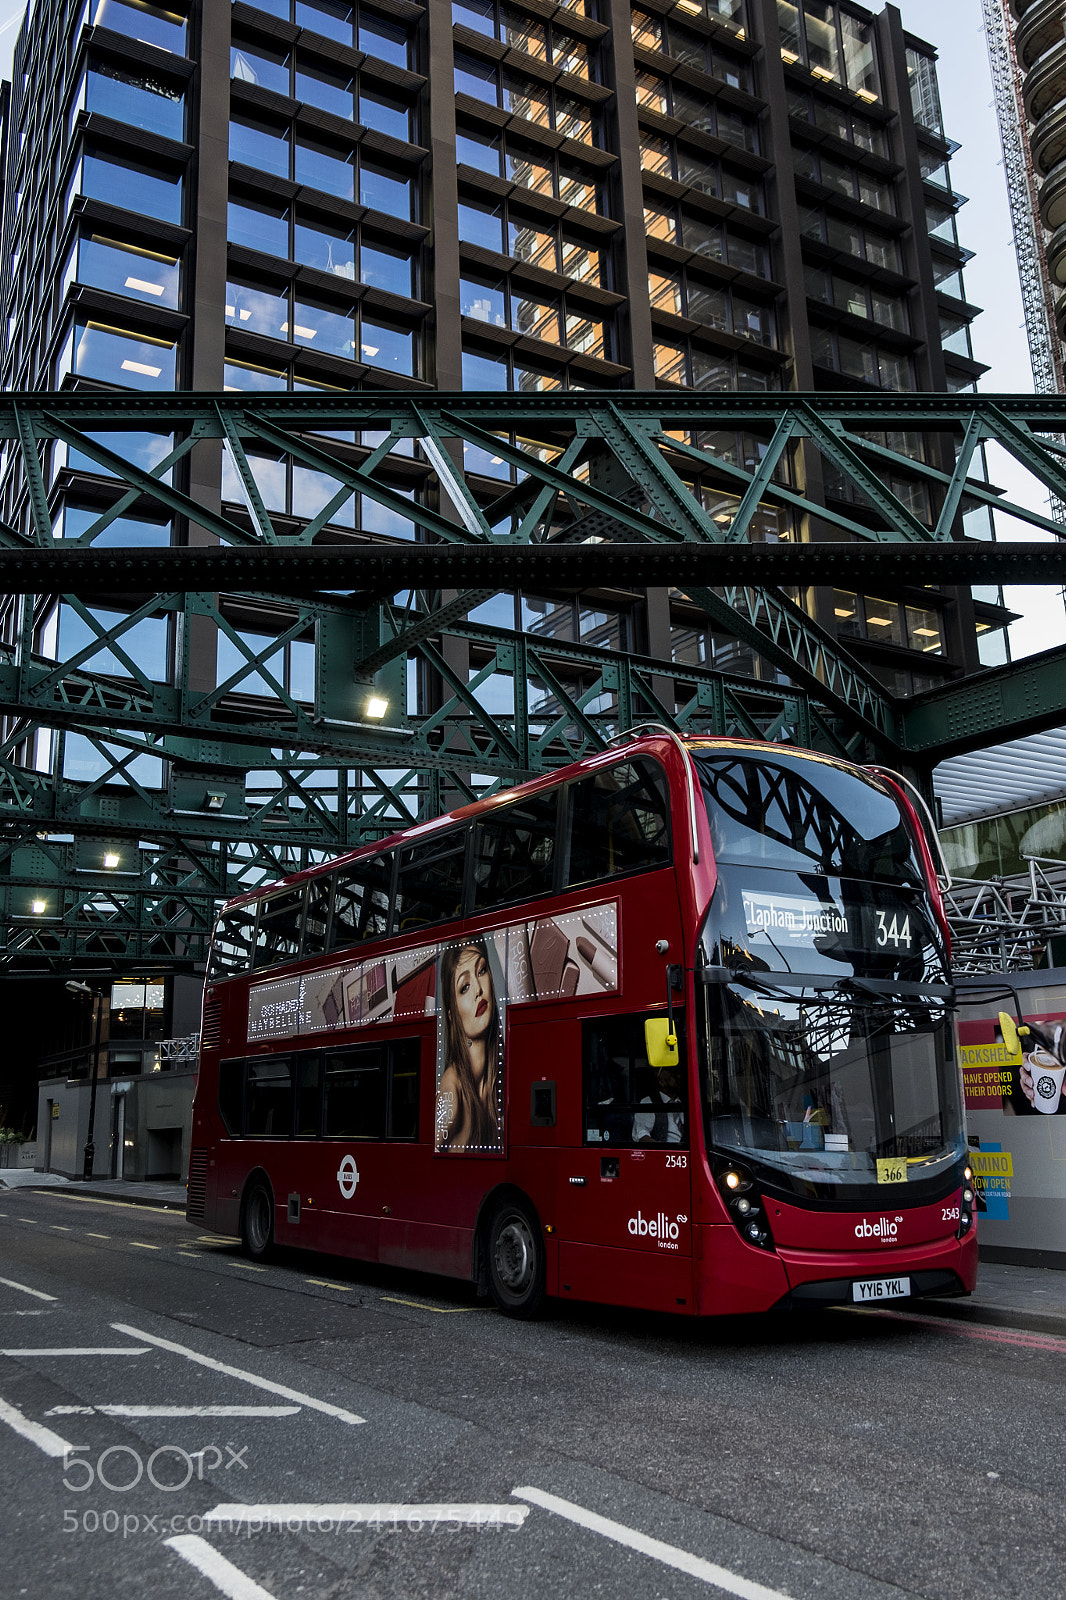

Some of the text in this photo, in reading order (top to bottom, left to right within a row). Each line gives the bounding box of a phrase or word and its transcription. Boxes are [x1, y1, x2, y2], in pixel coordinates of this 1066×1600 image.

[743, 900, 849, 933] Clapham Junction
[875, 910, 912, 949] 344
[961, 1047, 1015, 1064] ACKSHEE
[964, 1071, 1013, 1084] HAVE OPENED
[965, 1084, 1013, 1097] THEIR DOORS
[665, 1155, 687, 1168] 2543
[882, 1168, 903, 1182] 366
[990, 1178, 1010, 1189] OPEN
[942, 1208, 960, 1220] 2543
[628, 1210, 679, 1239] abellio
[855, 1217, 898, 1237] abellio
[658, 1241, 679, 1250] london
[860, 1280, 904, 1298] YY16 YKL
